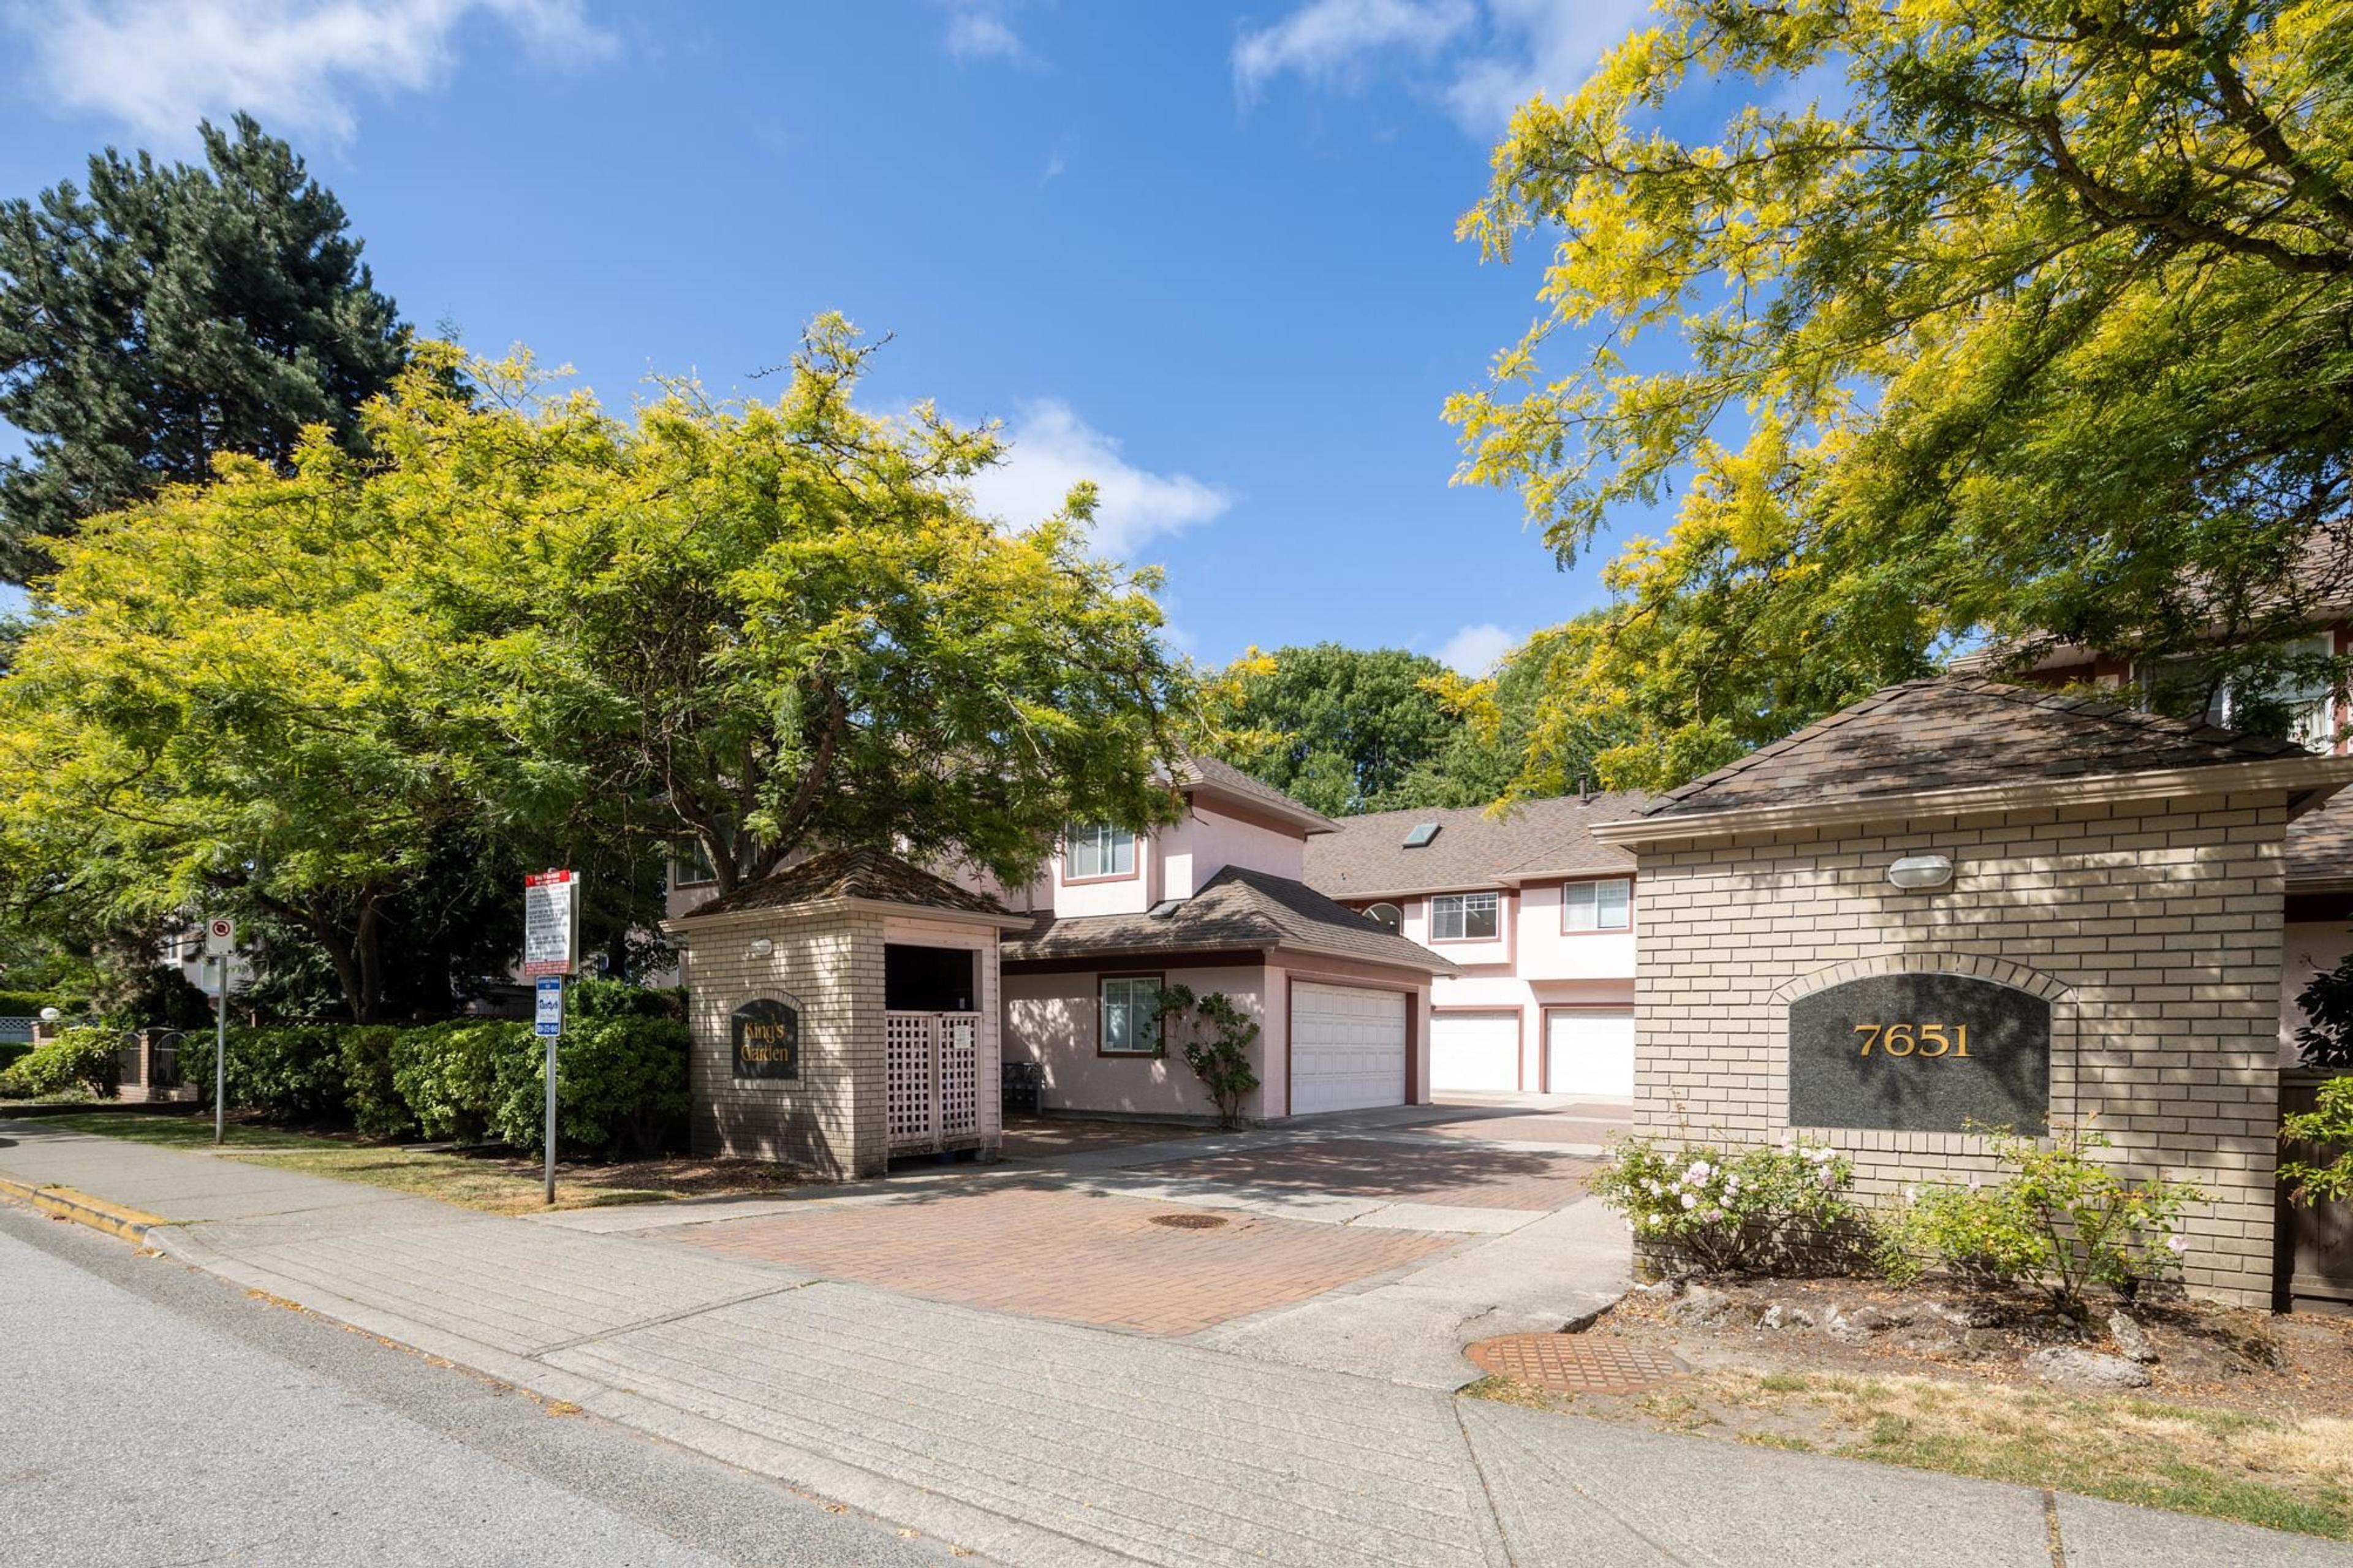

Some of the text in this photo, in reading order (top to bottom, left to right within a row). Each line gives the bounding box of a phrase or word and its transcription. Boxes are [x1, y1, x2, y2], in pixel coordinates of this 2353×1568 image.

[743, 1021, 785, 1043] King's
[1854, 1024, 1976, 1057] 7651
[741, 1044, 789, 1061] Garden
